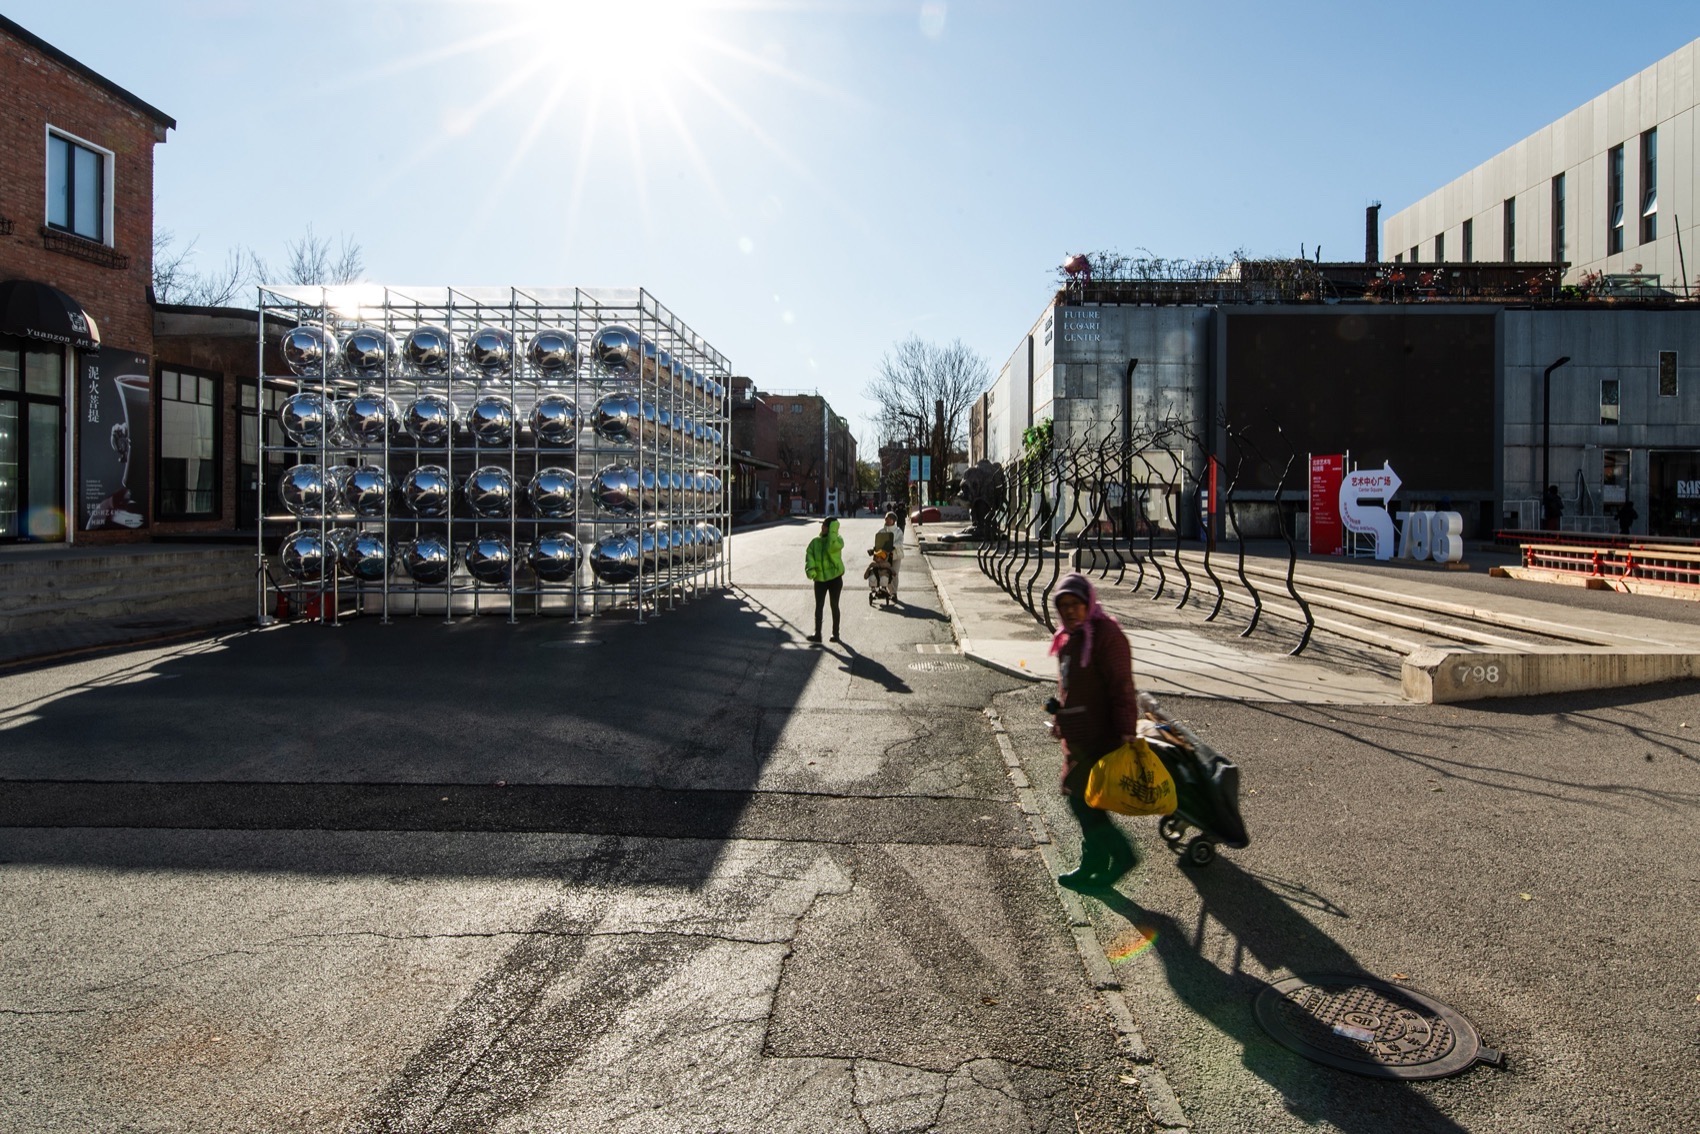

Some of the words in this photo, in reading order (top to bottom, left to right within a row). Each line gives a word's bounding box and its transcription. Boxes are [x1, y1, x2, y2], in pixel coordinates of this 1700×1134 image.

[1064, 311, 1100, 319] FUTURE
[26, 328, 70, 343] Yuanzon
[76, 338, 89, 347] Art
[1064, 334, 1100, 342] CENTER
[88, 366, 100, 423] 泥火菩提
[1351, 476, 1391, 487] 艺术中心广场
[1396, 511, 1463, 563] 798
[1458, 665, 1499, 683] 798
